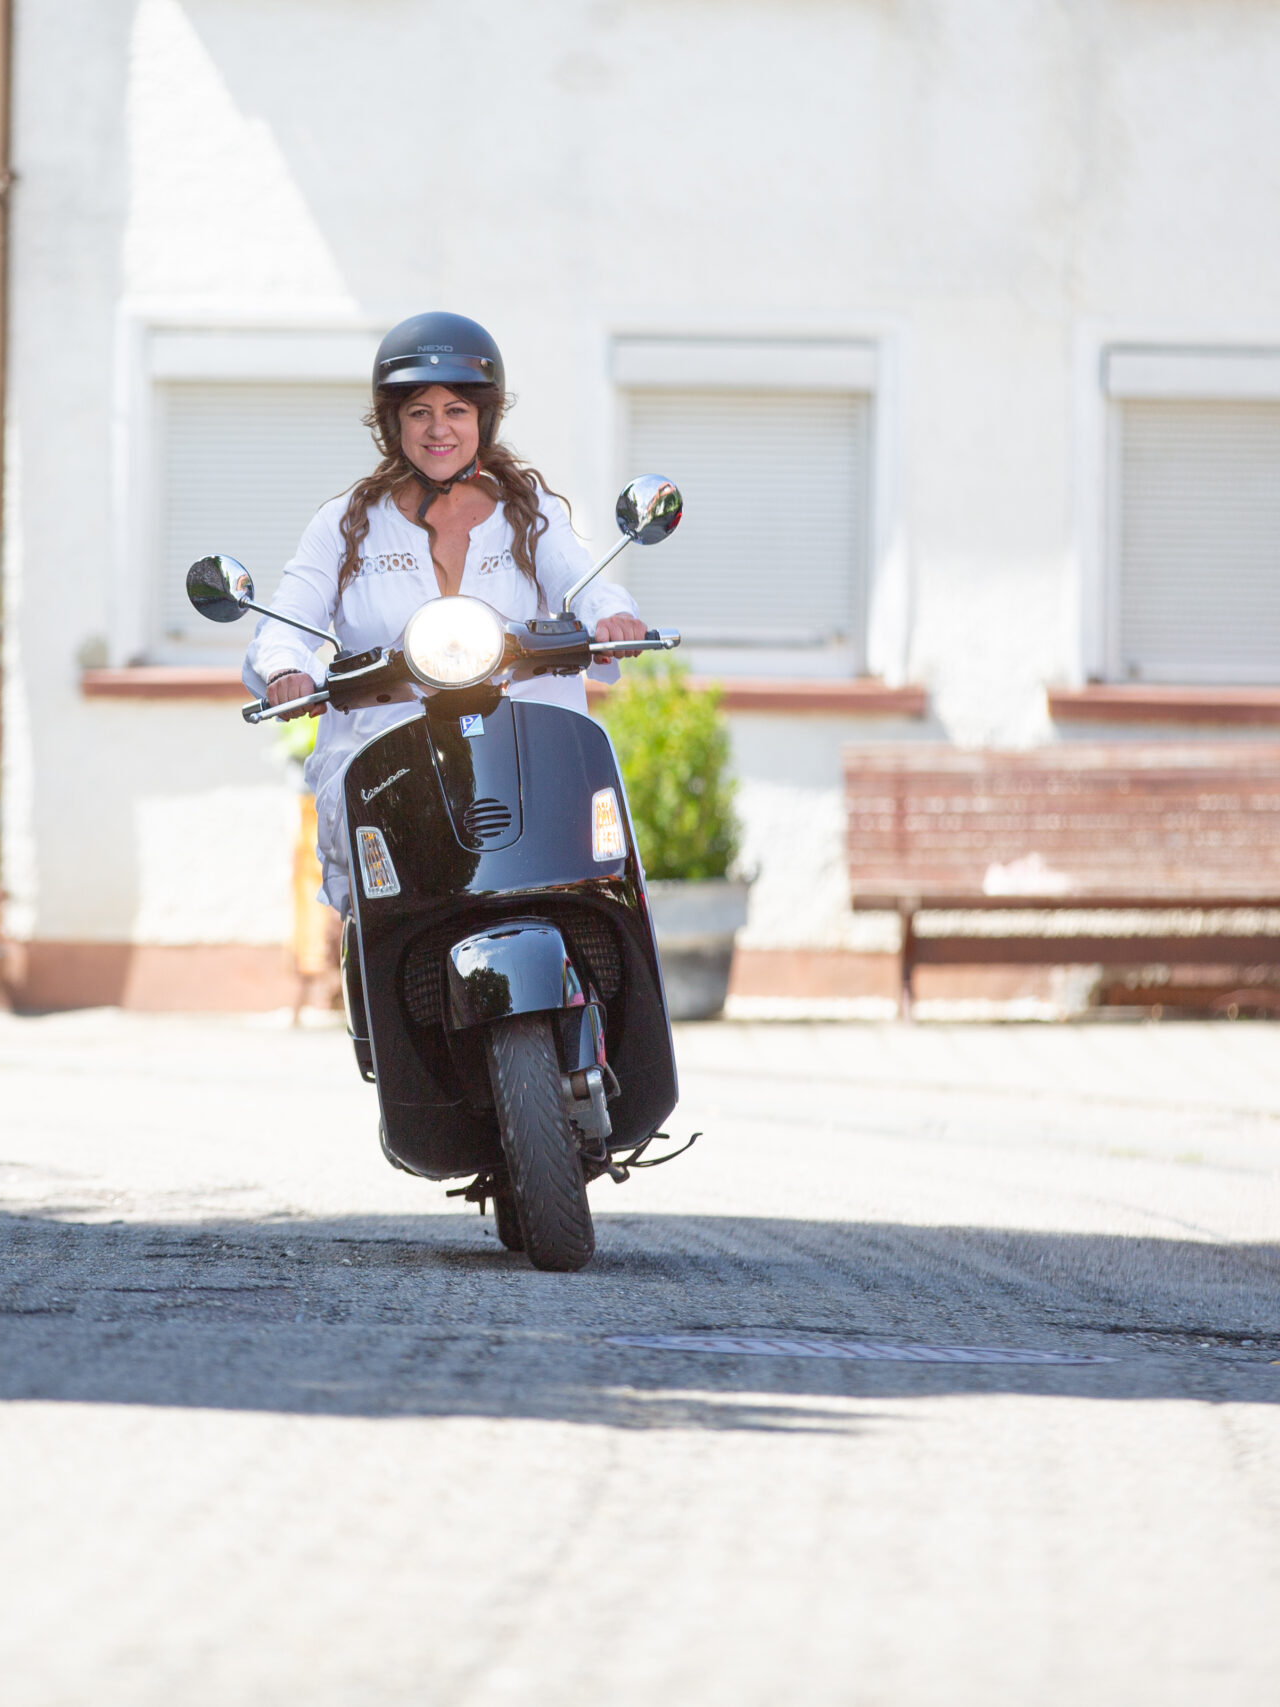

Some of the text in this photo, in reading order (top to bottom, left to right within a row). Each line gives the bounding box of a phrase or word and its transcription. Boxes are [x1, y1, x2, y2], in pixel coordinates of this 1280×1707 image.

[417, 344, 454, 353] NEXO
[462, 716, 474, 730] P
[361, 768, 410, 806] Vespa
